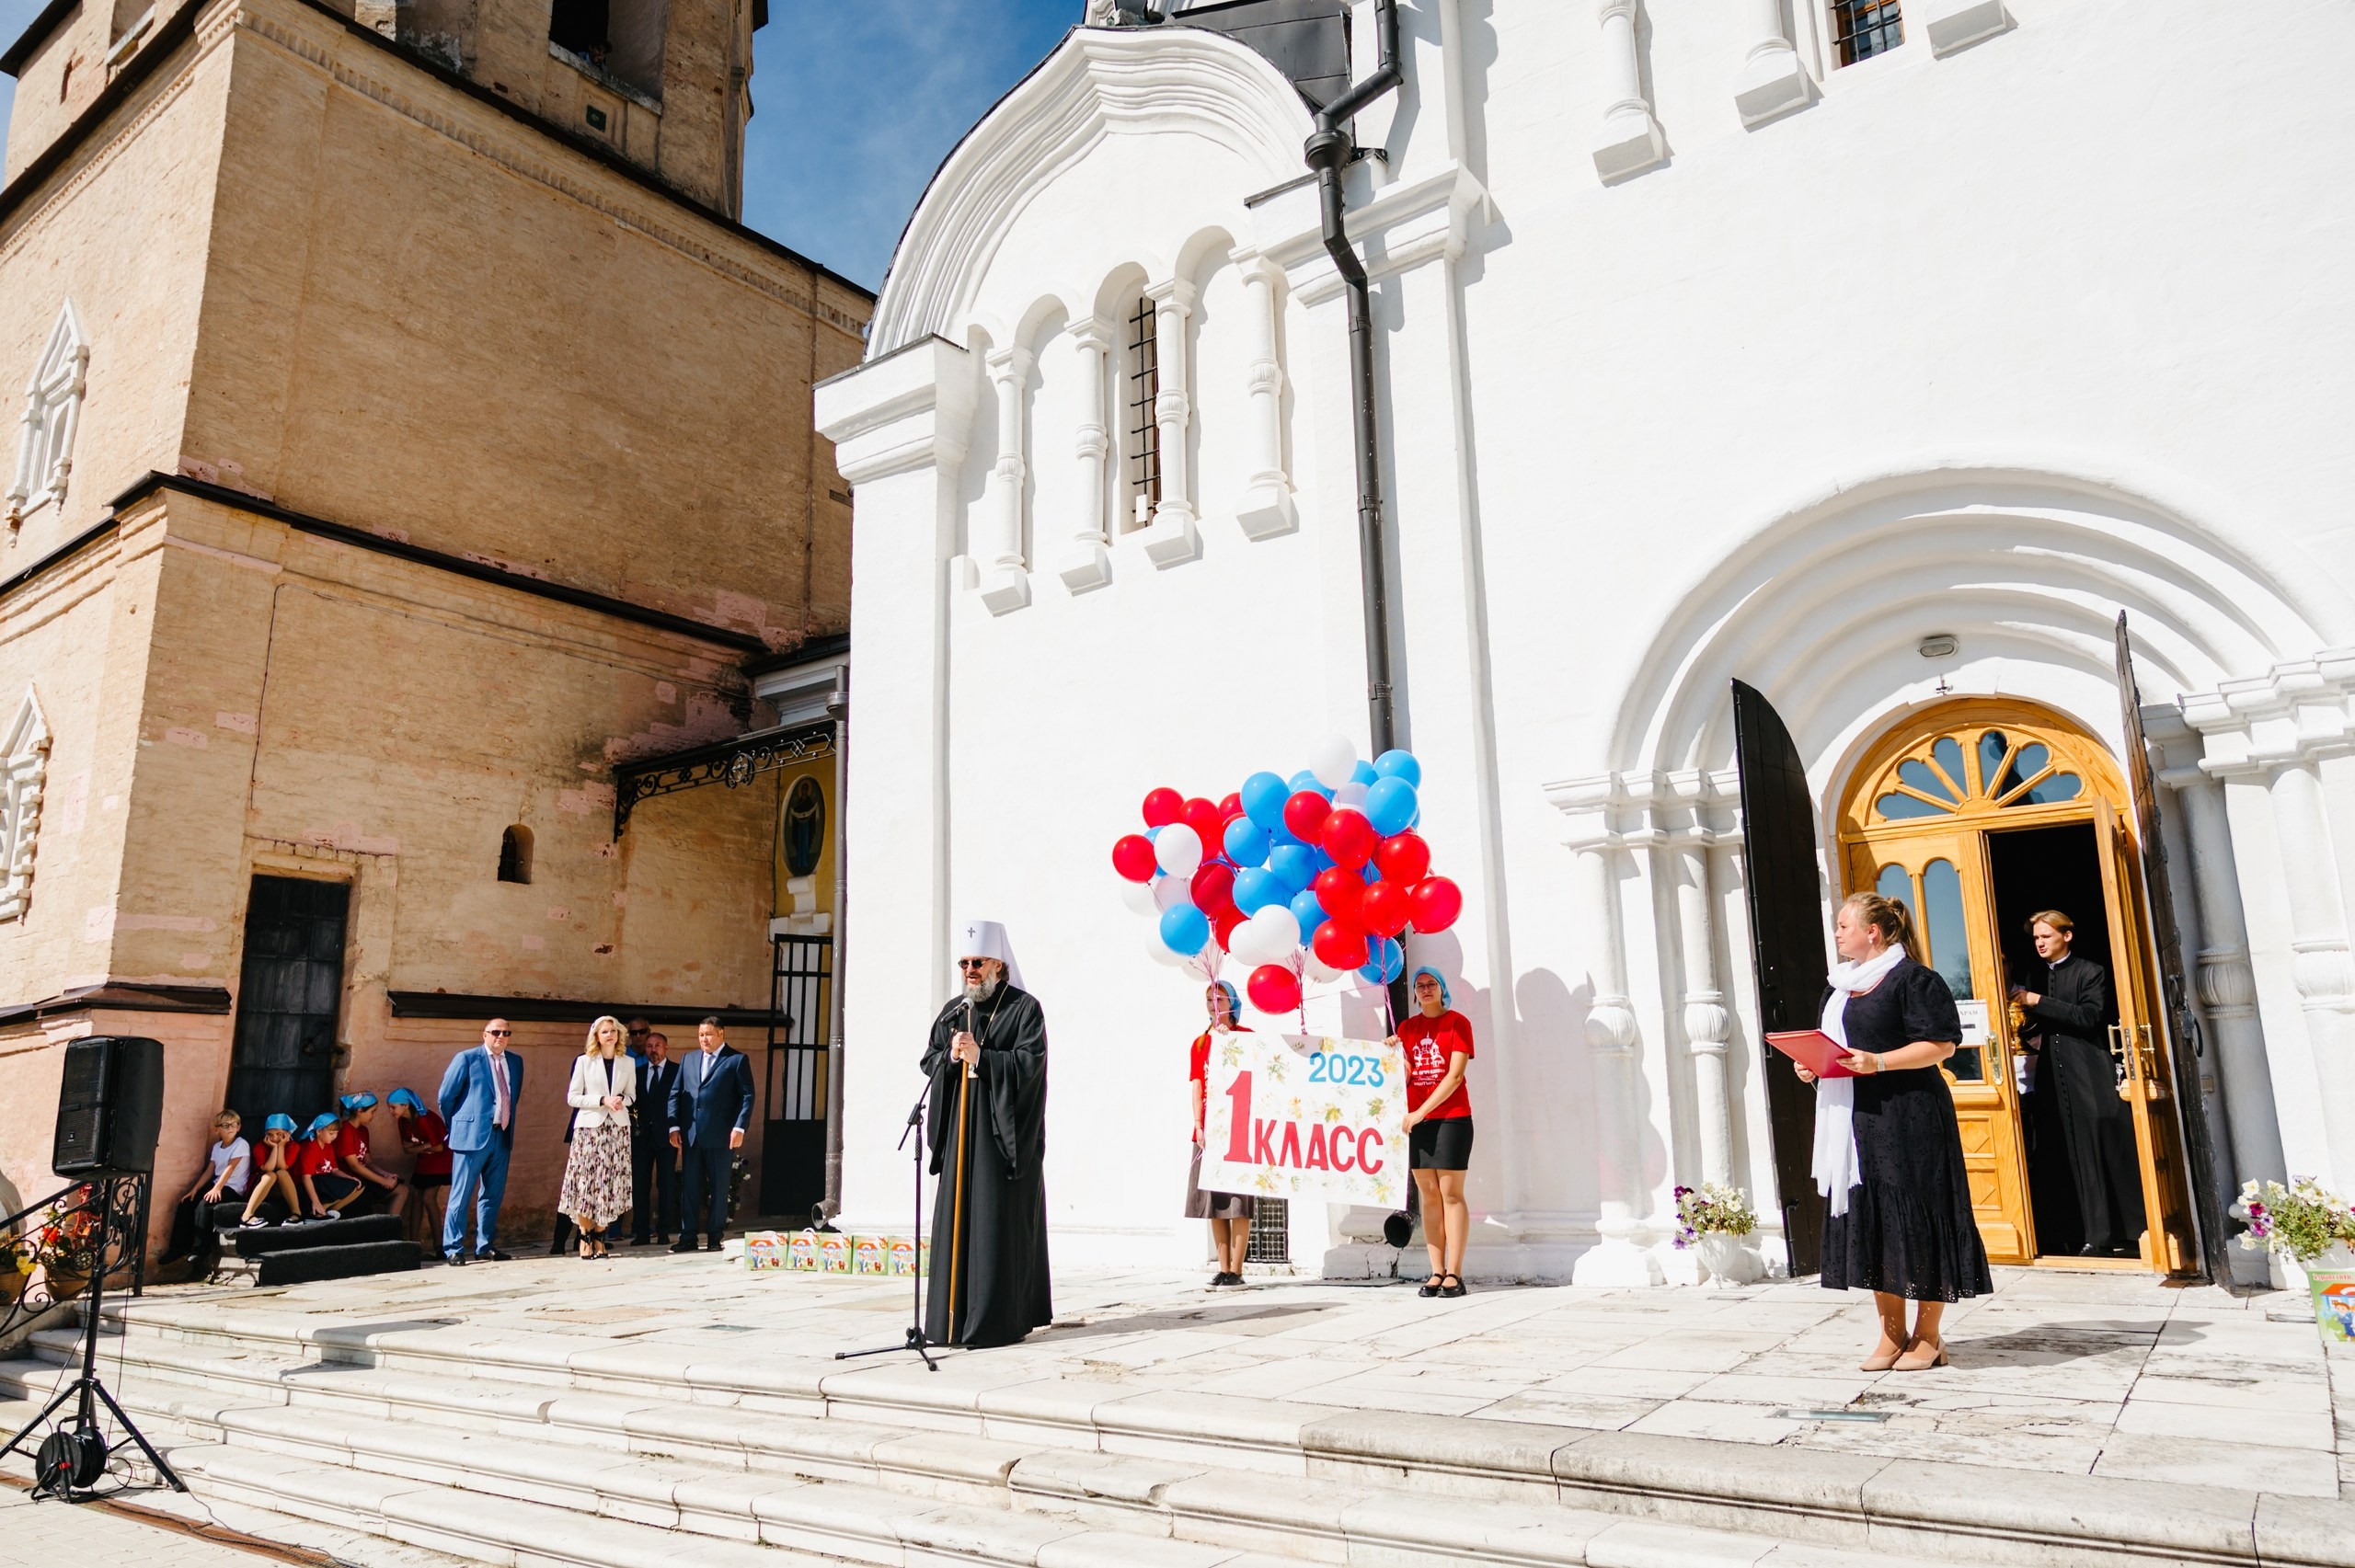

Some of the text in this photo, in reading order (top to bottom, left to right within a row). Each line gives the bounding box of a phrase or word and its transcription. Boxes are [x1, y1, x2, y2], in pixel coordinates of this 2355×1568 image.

[1309, 1051, 1384, 1088] 2023
[1223, 1070, 1384, 1175] 1 КЛАСС
